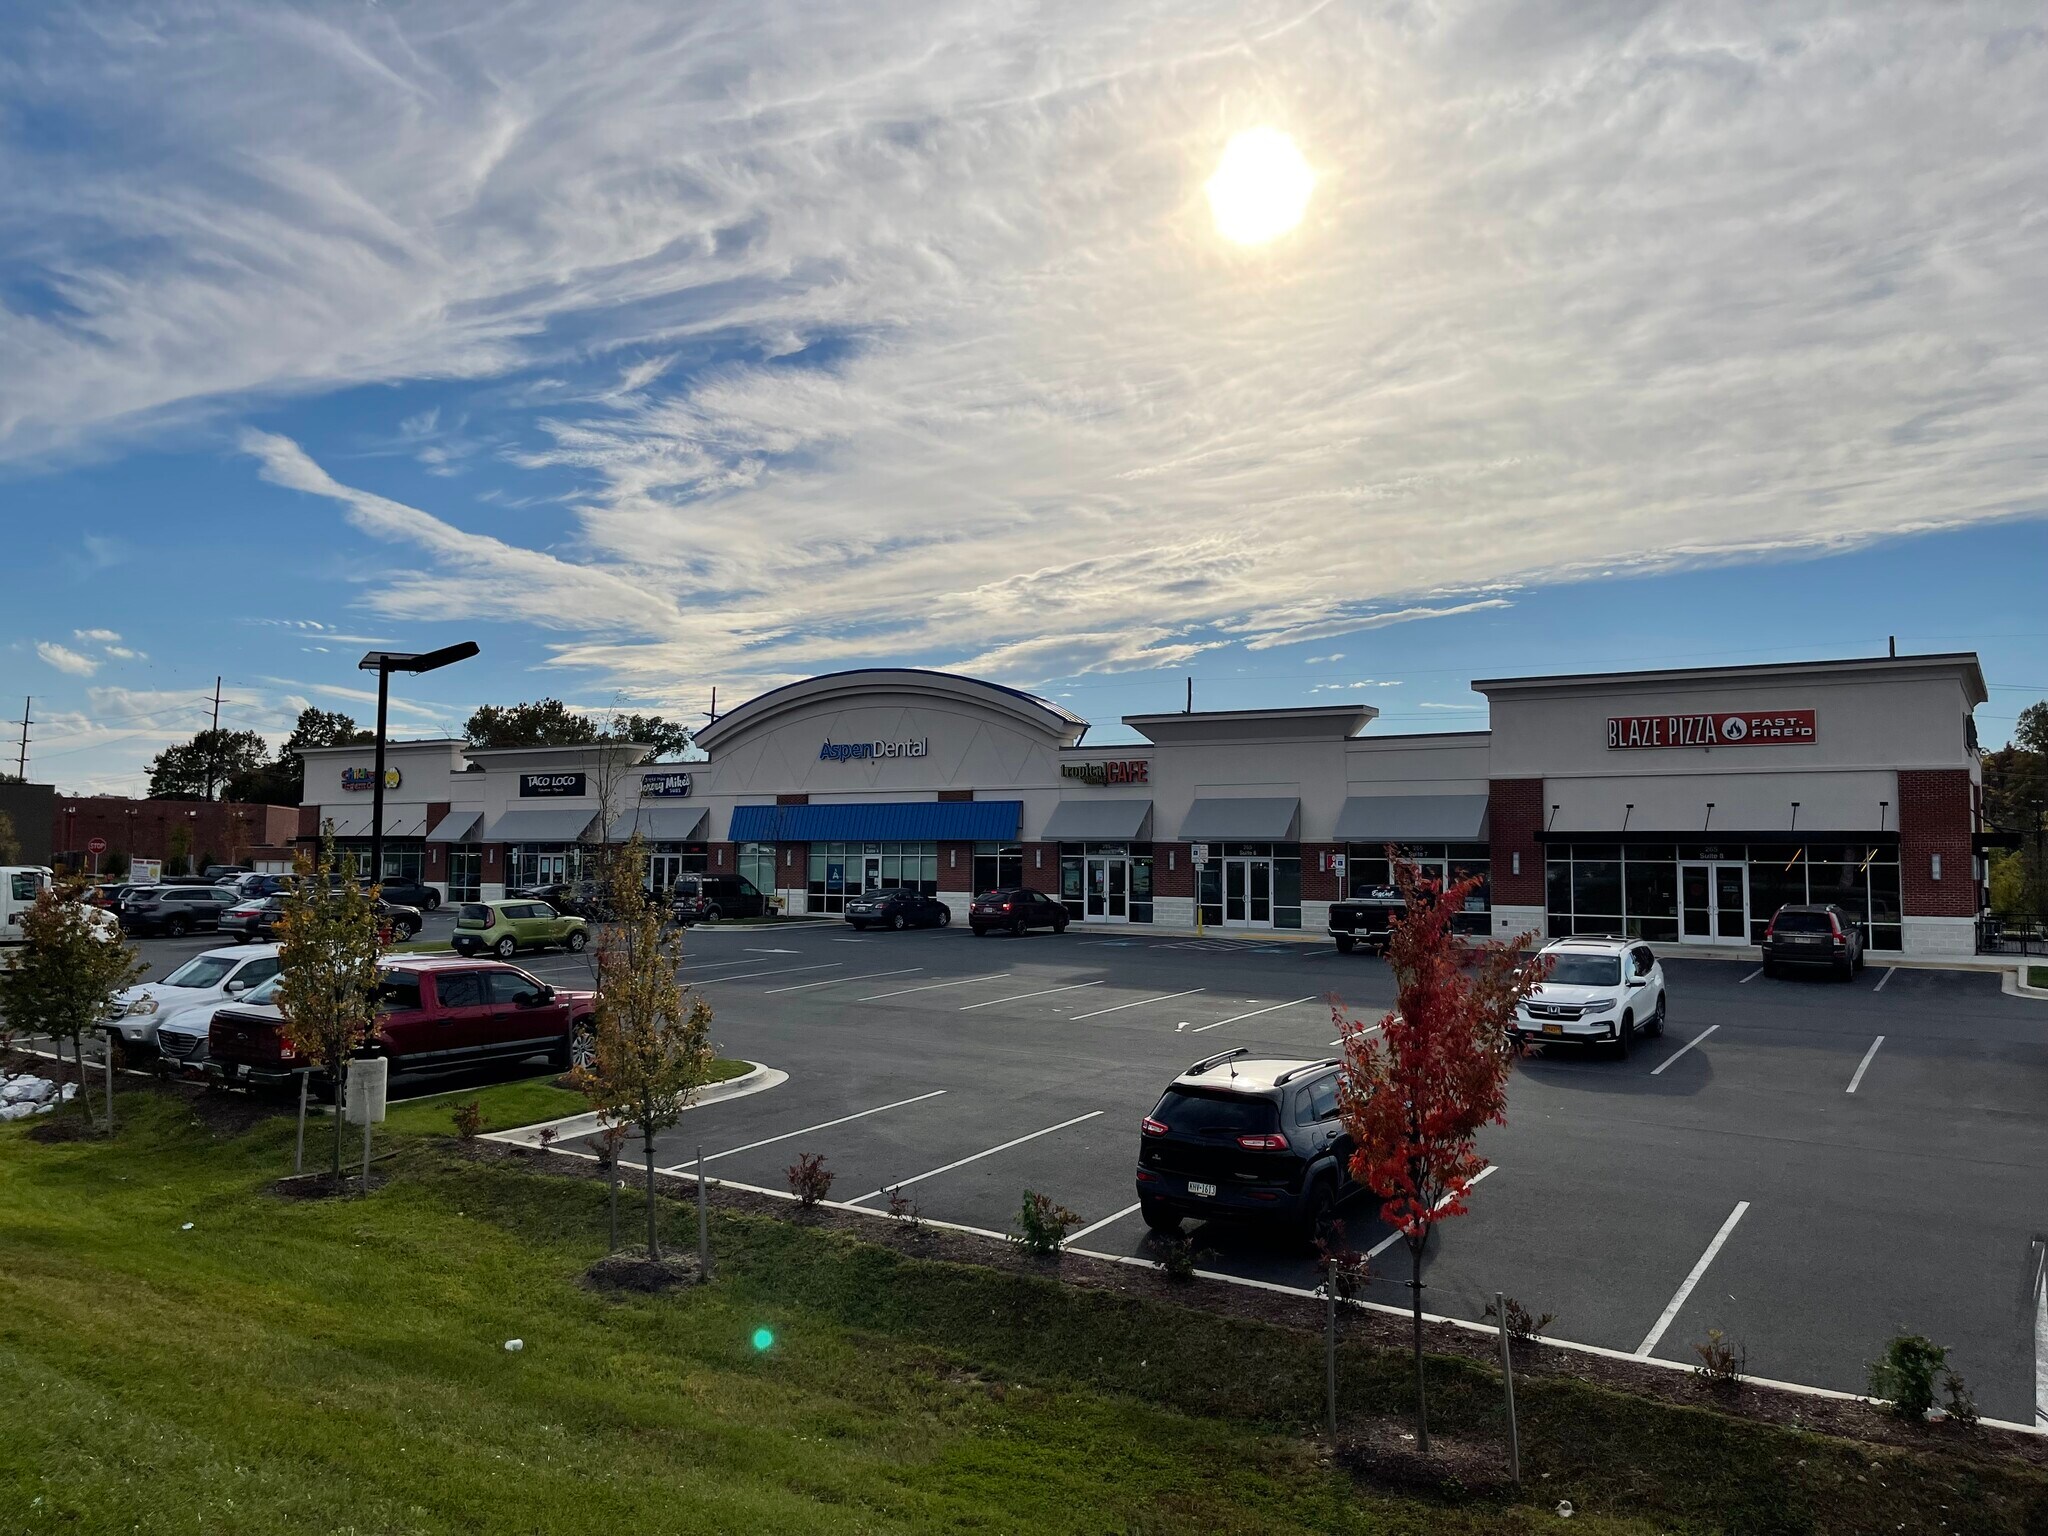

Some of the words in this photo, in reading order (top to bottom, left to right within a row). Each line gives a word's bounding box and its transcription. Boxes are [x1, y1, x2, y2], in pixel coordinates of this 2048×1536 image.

[1752, 718, 1804, 727] FAST-
[1608, 719, 1661, 747] BLAZE
[1669, 716, 1717, 744] PIZZA
[1752, 728, 1813, 737] FIRE'D
[1061, 762, 1107, 780] tropical
[1107, 761, 1148, 783] CAFE
[527, 776, 550, 787] TACO
[552, 776, 576, 786] LOCO
[665, 775, 690, 789] Mike's
[1700, 852, 1716, 860] Suite
